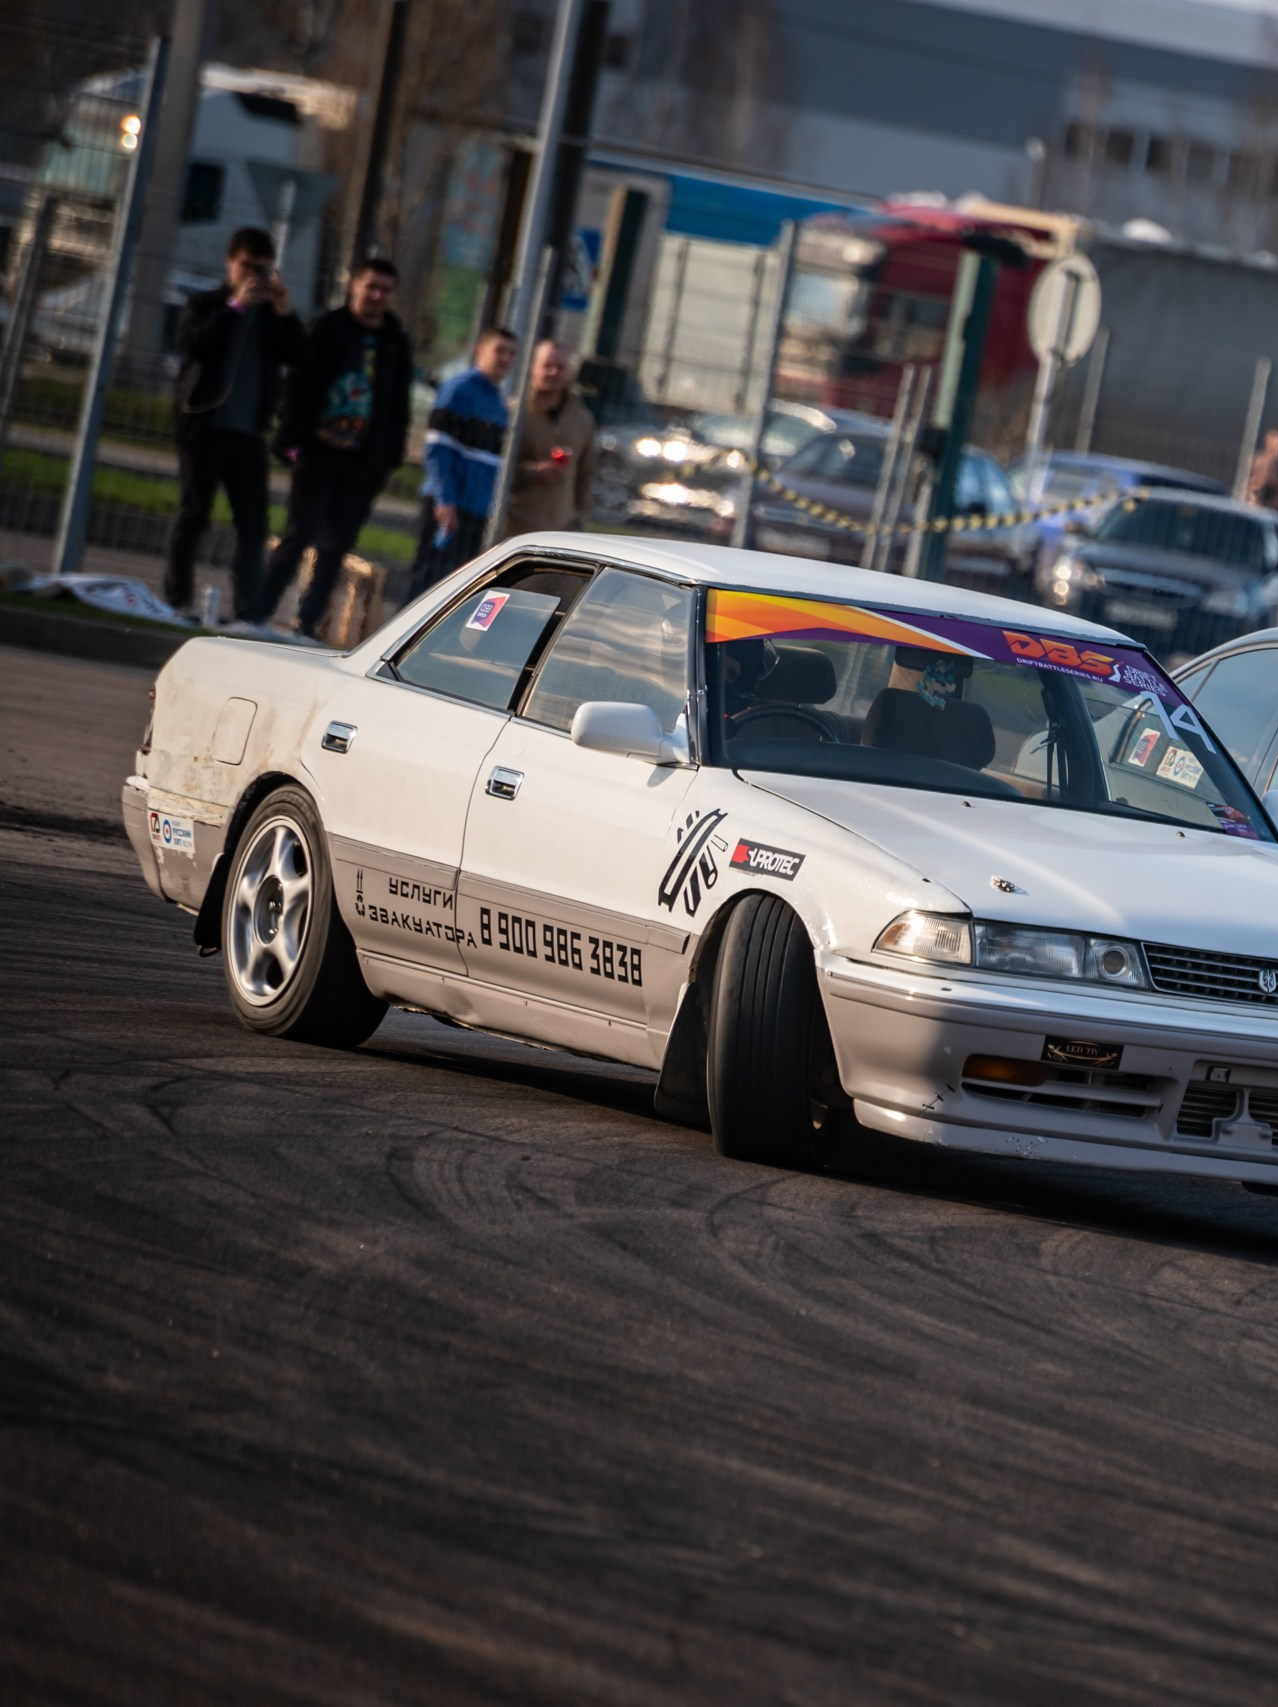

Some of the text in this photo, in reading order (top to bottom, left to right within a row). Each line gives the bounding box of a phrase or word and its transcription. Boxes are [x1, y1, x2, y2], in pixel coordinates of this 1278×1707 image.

[1002, 630, 1115, 676] DBS
[1016, 657, 1103, 682] DRIFTBATTLESERIES.RU
[1125, 665, 1158, 683] DRIFT
[1140, 690, 1216, 754] 14
[388, 877, 454, 910] УСЛУГИ
[368, 904, 478, 949] ЭВАКУАТОРА
[479, 906, 643, 988] 8 900 986 3838
[1066, 1044, 1083, 1054] LED
